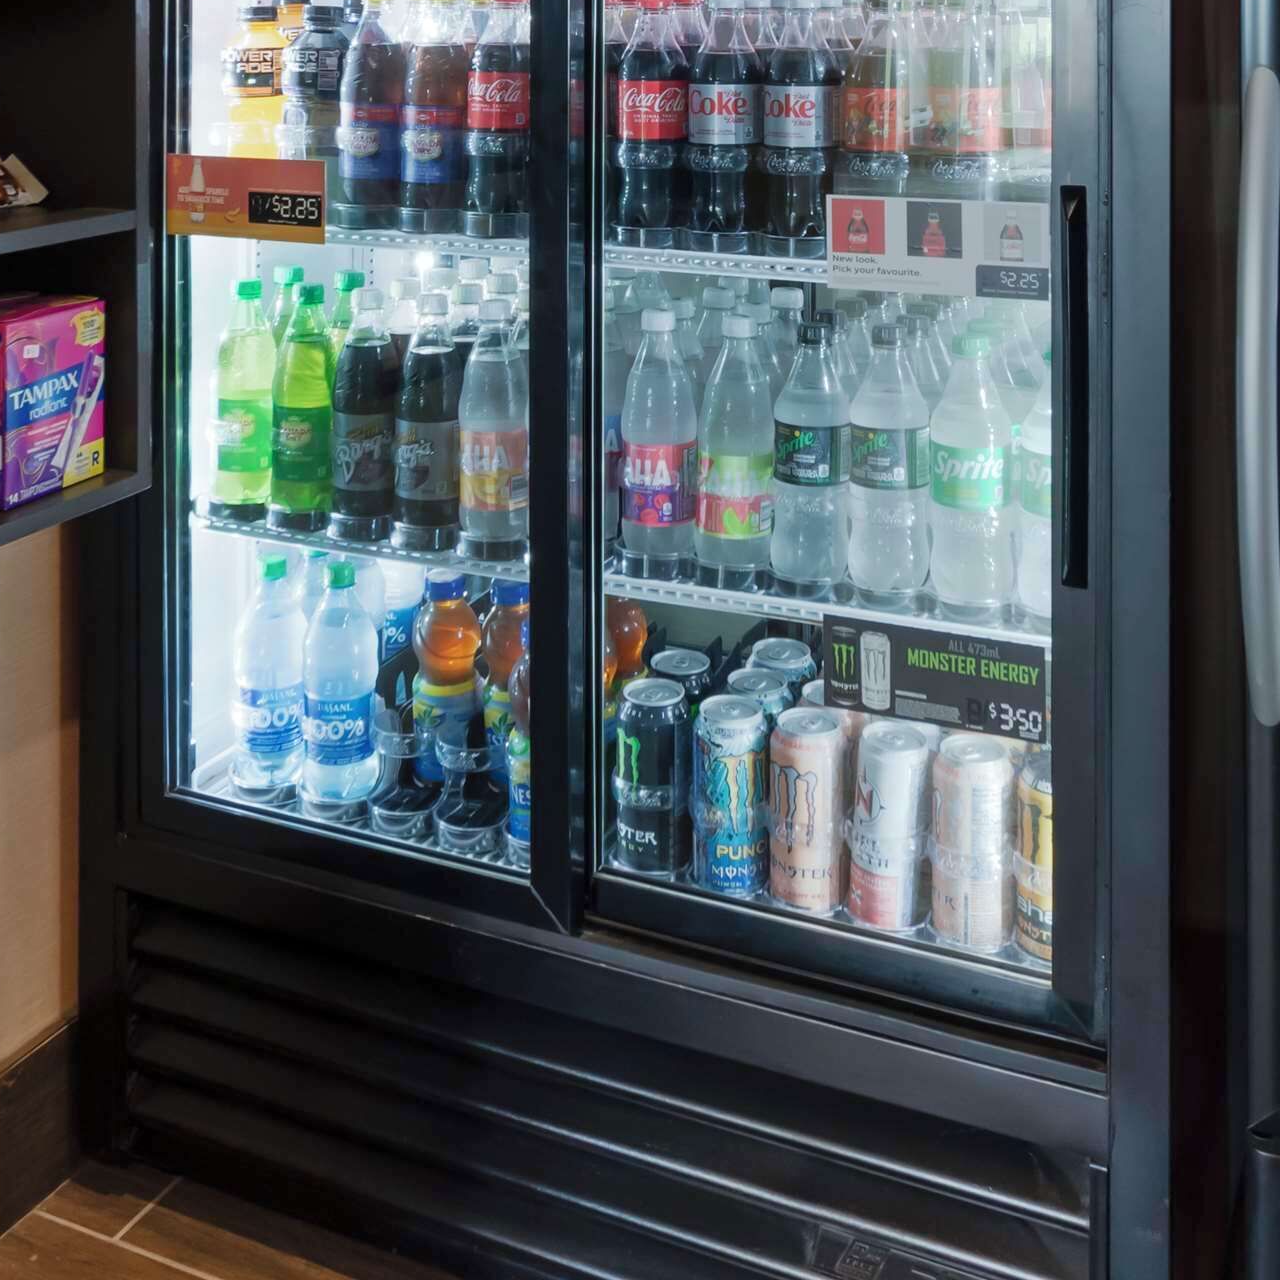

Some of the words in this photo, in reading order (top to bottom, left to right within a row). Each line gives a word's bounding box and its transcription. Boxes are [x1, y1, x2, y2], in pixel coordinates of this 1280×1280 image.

[622, 87, 685, 113] Coca-Cola
[690, 89, 749, 116] Coke
[832, 254, 853, 264] New
[854, 254, 878, 265] look.
[832, 264, 853, 274] Pick
[853, 267, 875, 278] your
[876, 266, 922, 277] favourite.
[999, 271, 1040, 289] $2.25
[10, 367, 80, 411] TAMPAX
[91, 450, 100, 467] R
[936, 445, 1004, 482] Sprite
[624, 458, 672, 487] AHA
[948, 639, 966, 652] ALL
[967, 642, 1001, 660] 473mL
[907, 647, 977, 675] MONSTER
[980, 659, 1040, 687] ENERGY
